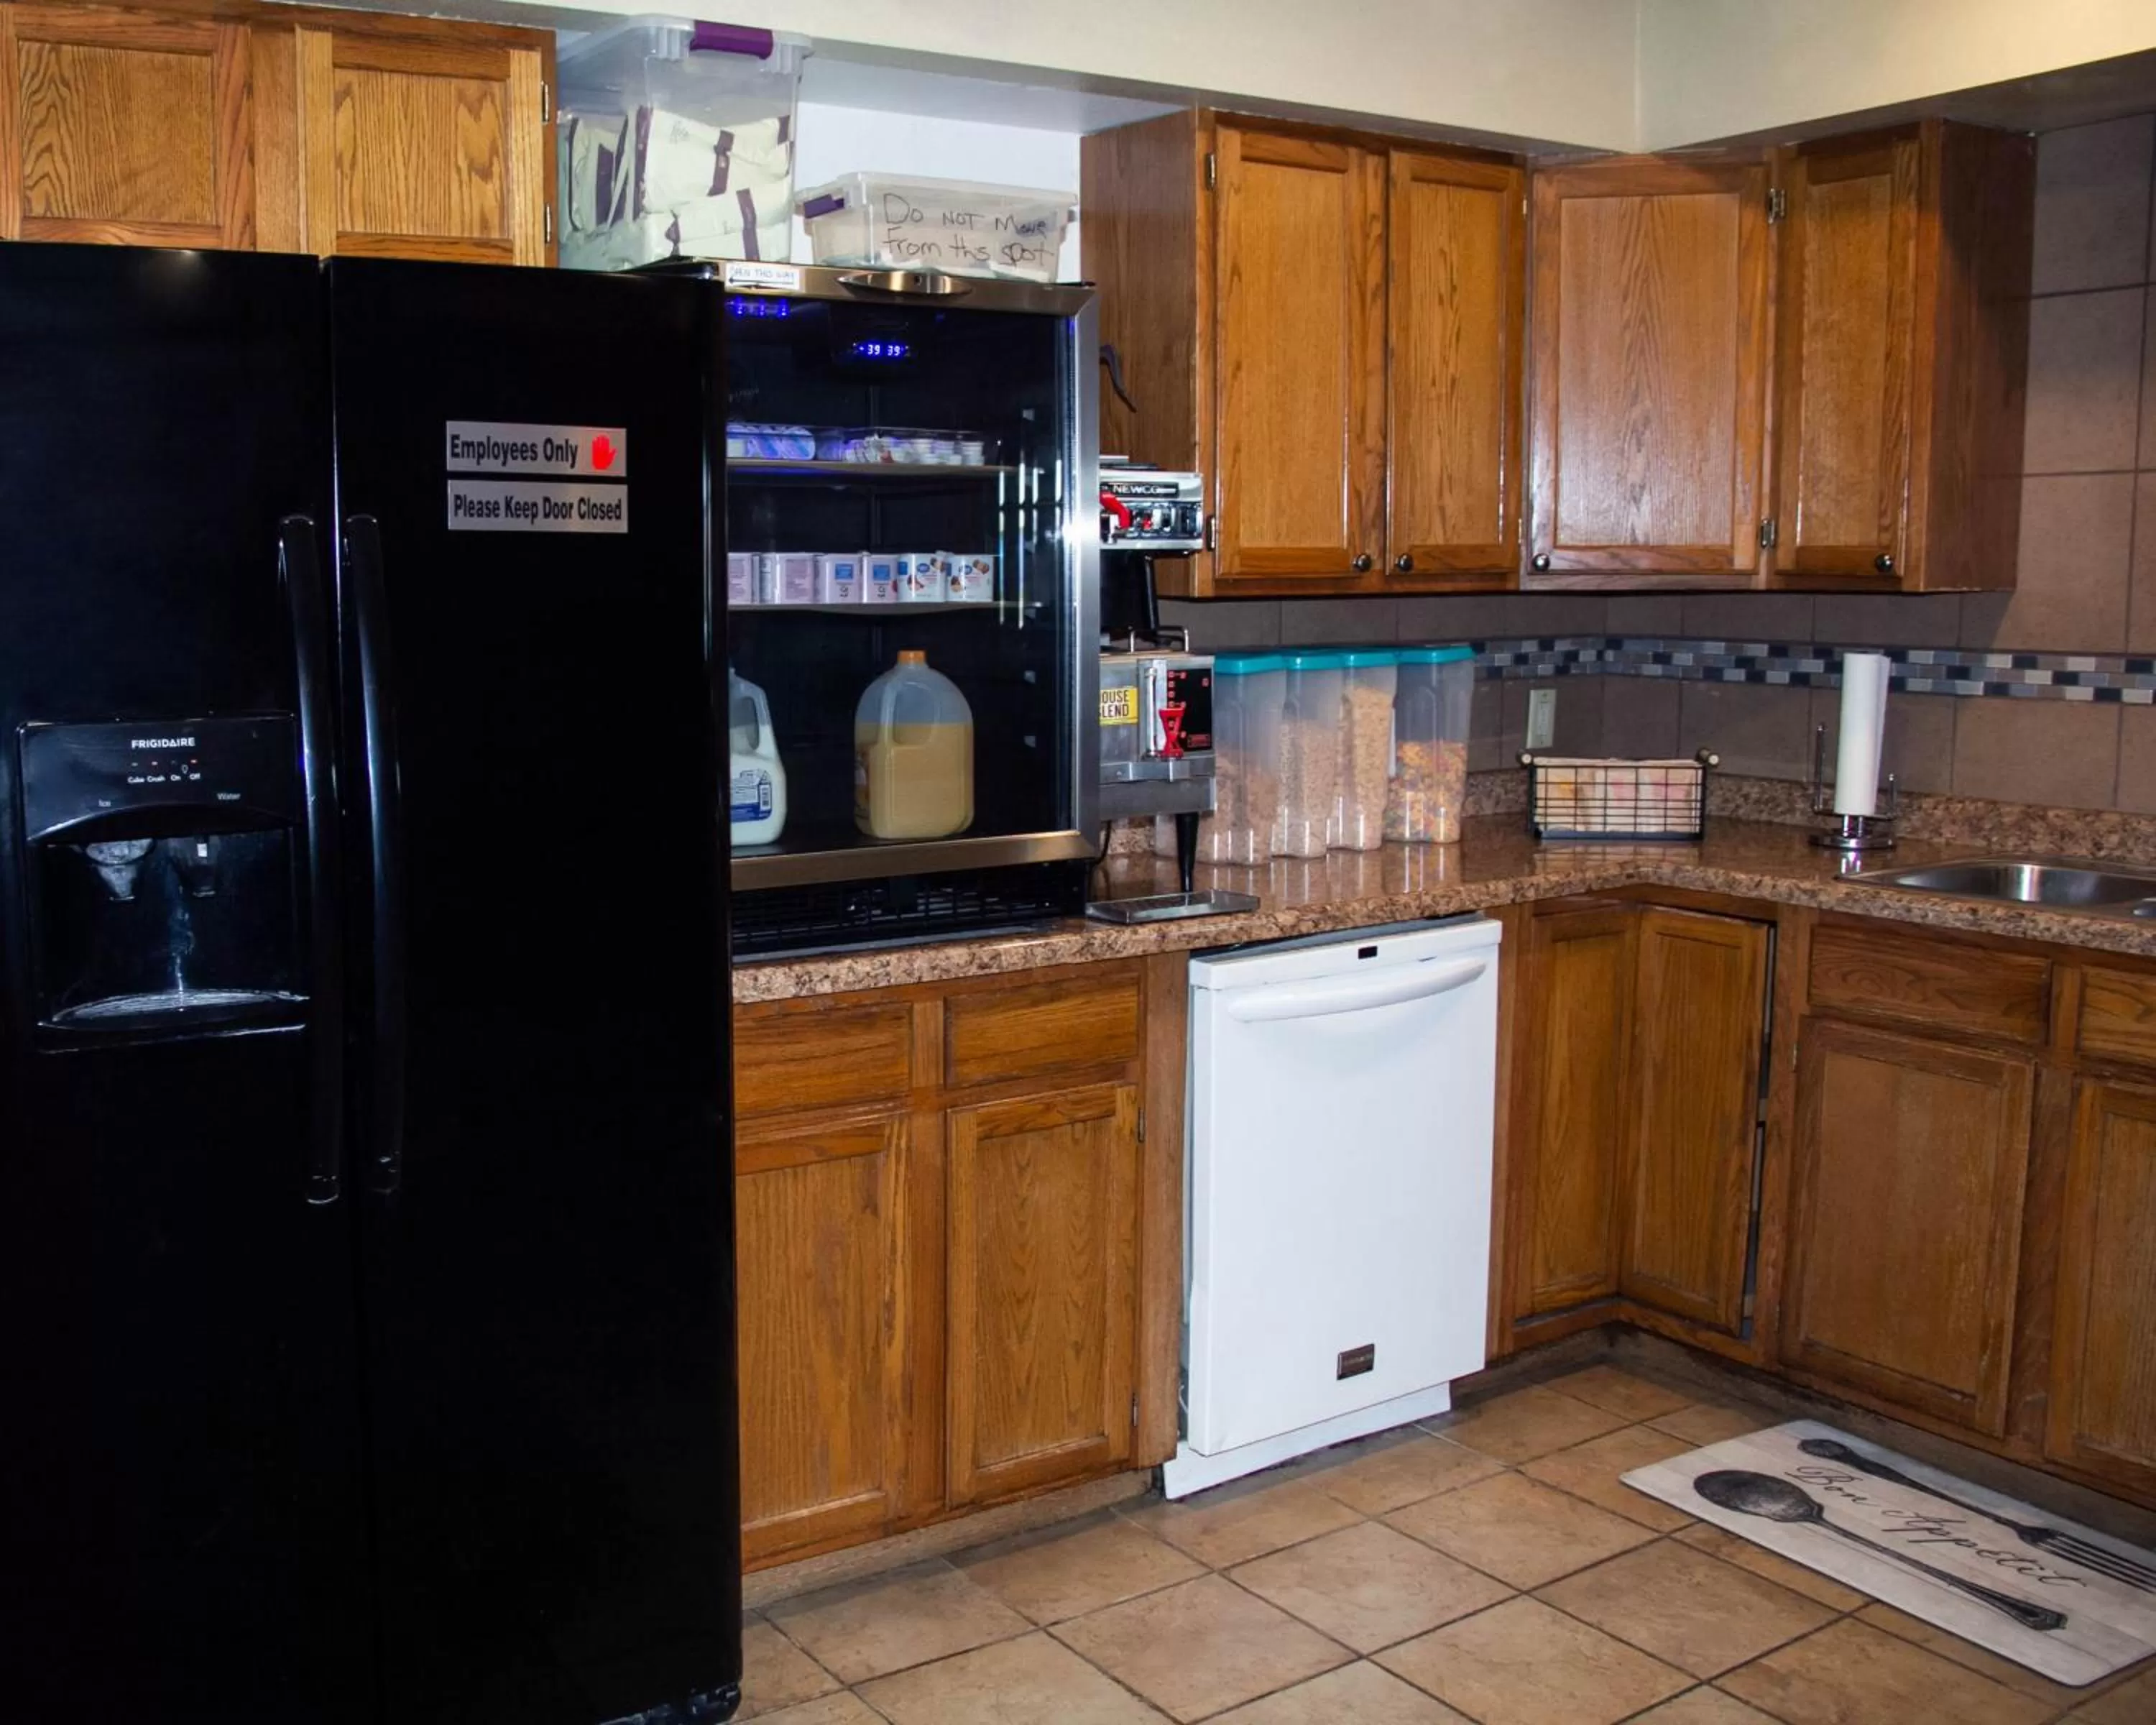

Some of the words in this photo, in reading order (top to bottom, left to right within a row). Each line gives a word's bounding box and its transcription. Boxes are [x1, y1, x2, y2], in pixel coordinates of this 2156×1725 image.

[883, 193, 923, 224] Do
[883, 226, 941, 257] From
[867, 344, 880, 356] 39
[888, 345, 900, 356] 39
[451, 434, 538, 467] Employees
[543, 437, 578, 469] Only
[453, 494, 501, 518] Please
[505, 495, 539, 525] Keep
[543, 496, 574, 520] Door
[577, 497, 622, 521] Closed
[1100, 690, 1130, 703] OUSE
[1100, 704, 1129, 717] LEND
[132, 737, 196, 750] FRIGIDAIRE
[1785, 1466, 1878, 1506] Bon
